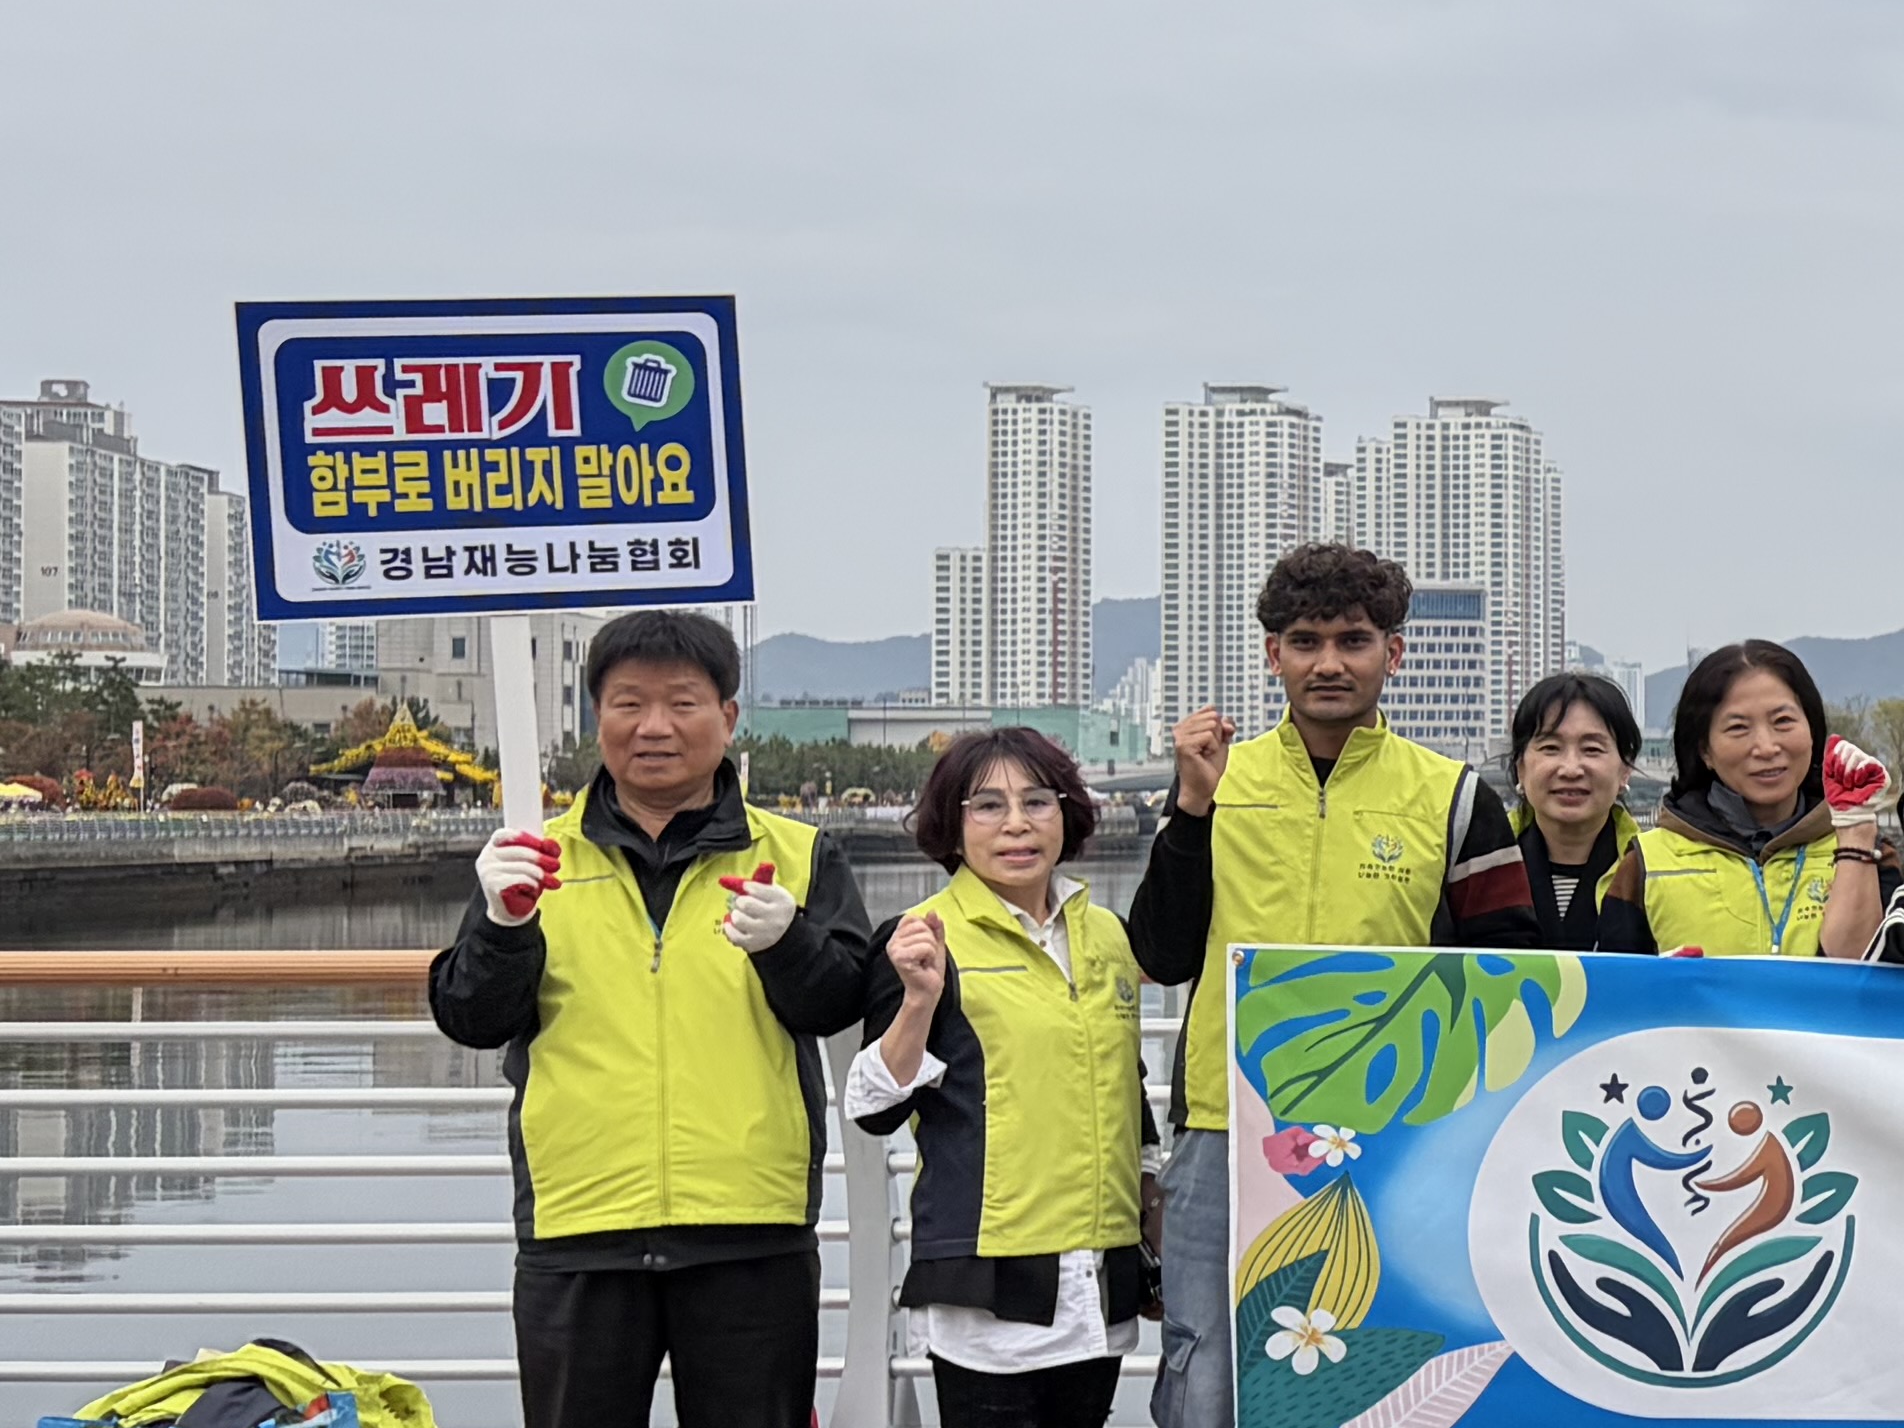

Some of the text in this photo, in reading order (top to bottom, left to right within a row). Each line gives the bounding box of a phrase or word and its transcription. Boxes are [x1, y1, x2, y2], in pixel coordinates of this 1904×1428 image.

[308, 357, 578, 440] 쓰레기
[307, 442, 695, 517] 함부로 버리지 말아요
[379, 536, 702, 581] 경남재능나눔협회
